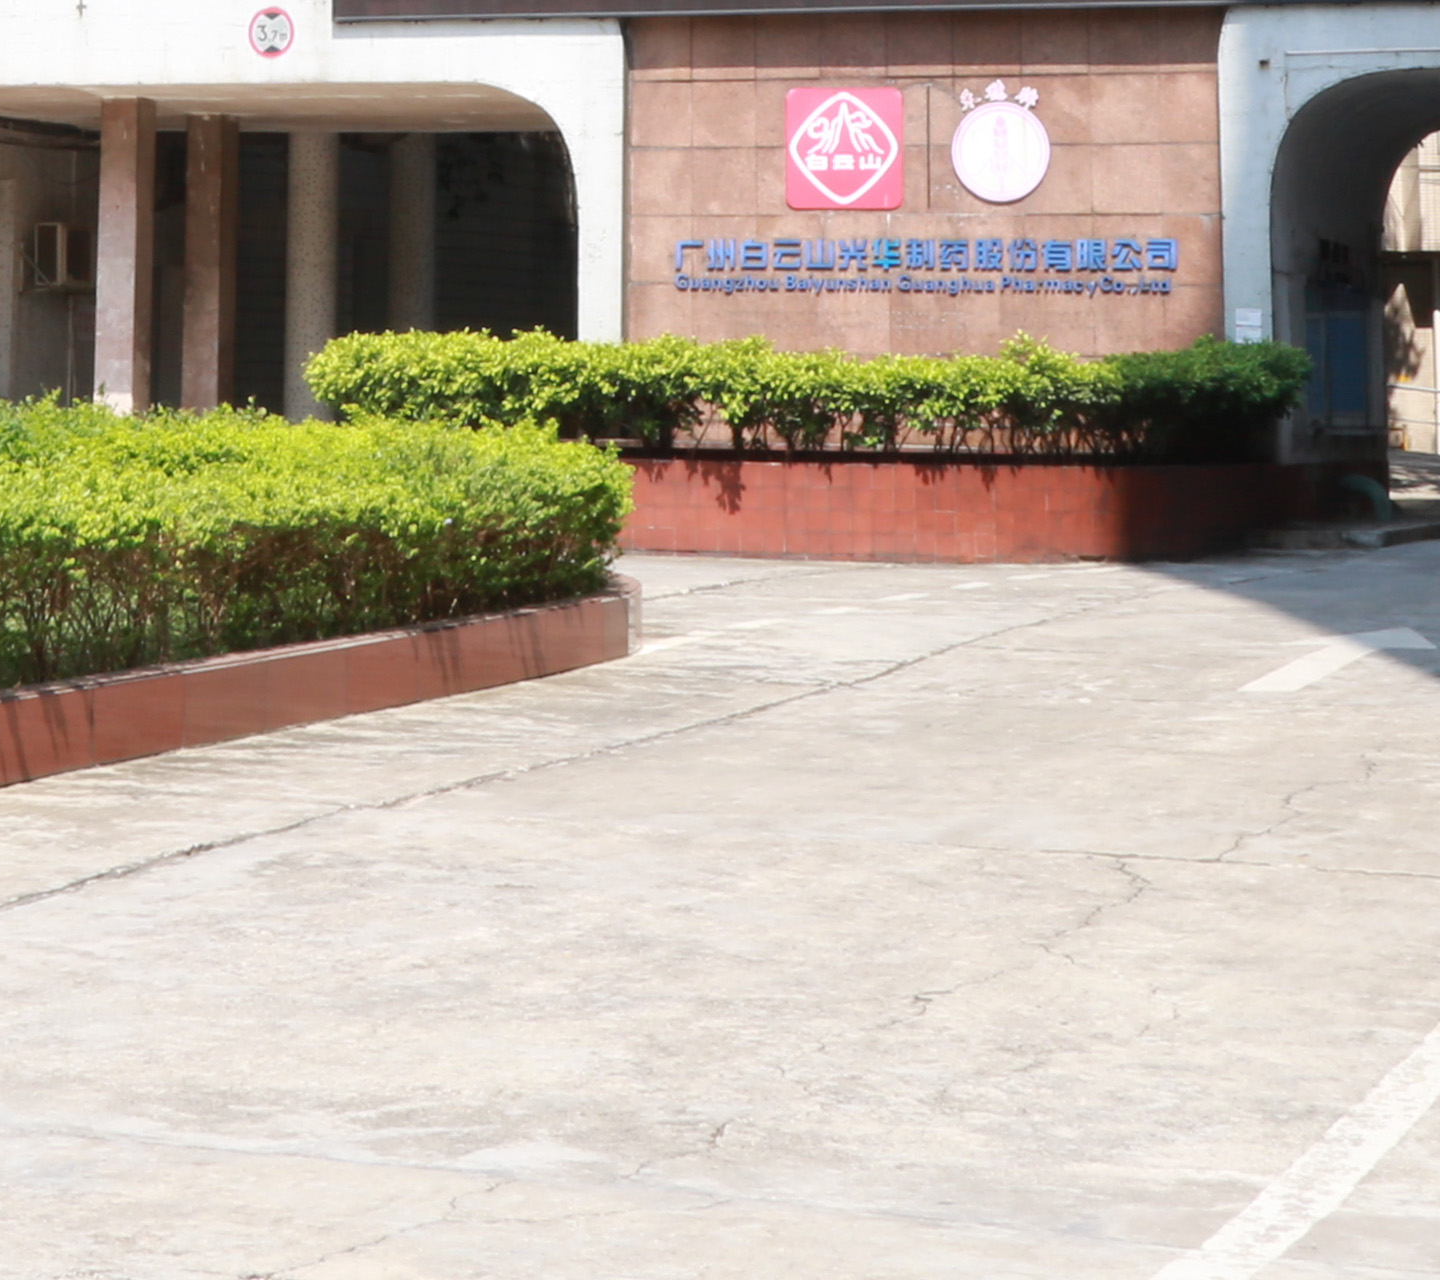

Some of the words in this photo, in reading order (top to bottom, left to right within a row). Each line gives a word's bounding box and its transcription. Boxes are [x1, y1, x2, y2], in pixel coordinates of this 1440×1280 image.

[805, 153, 882, 171] 白云山
[675, 238, 1178, 272] 广州白云山光华制药股份有限公司
[675, 274, 779, 295] Guangzhou
[784, 274, 893, 296] Baiyunshan
[896, 276, 995, 296] Guanghua
